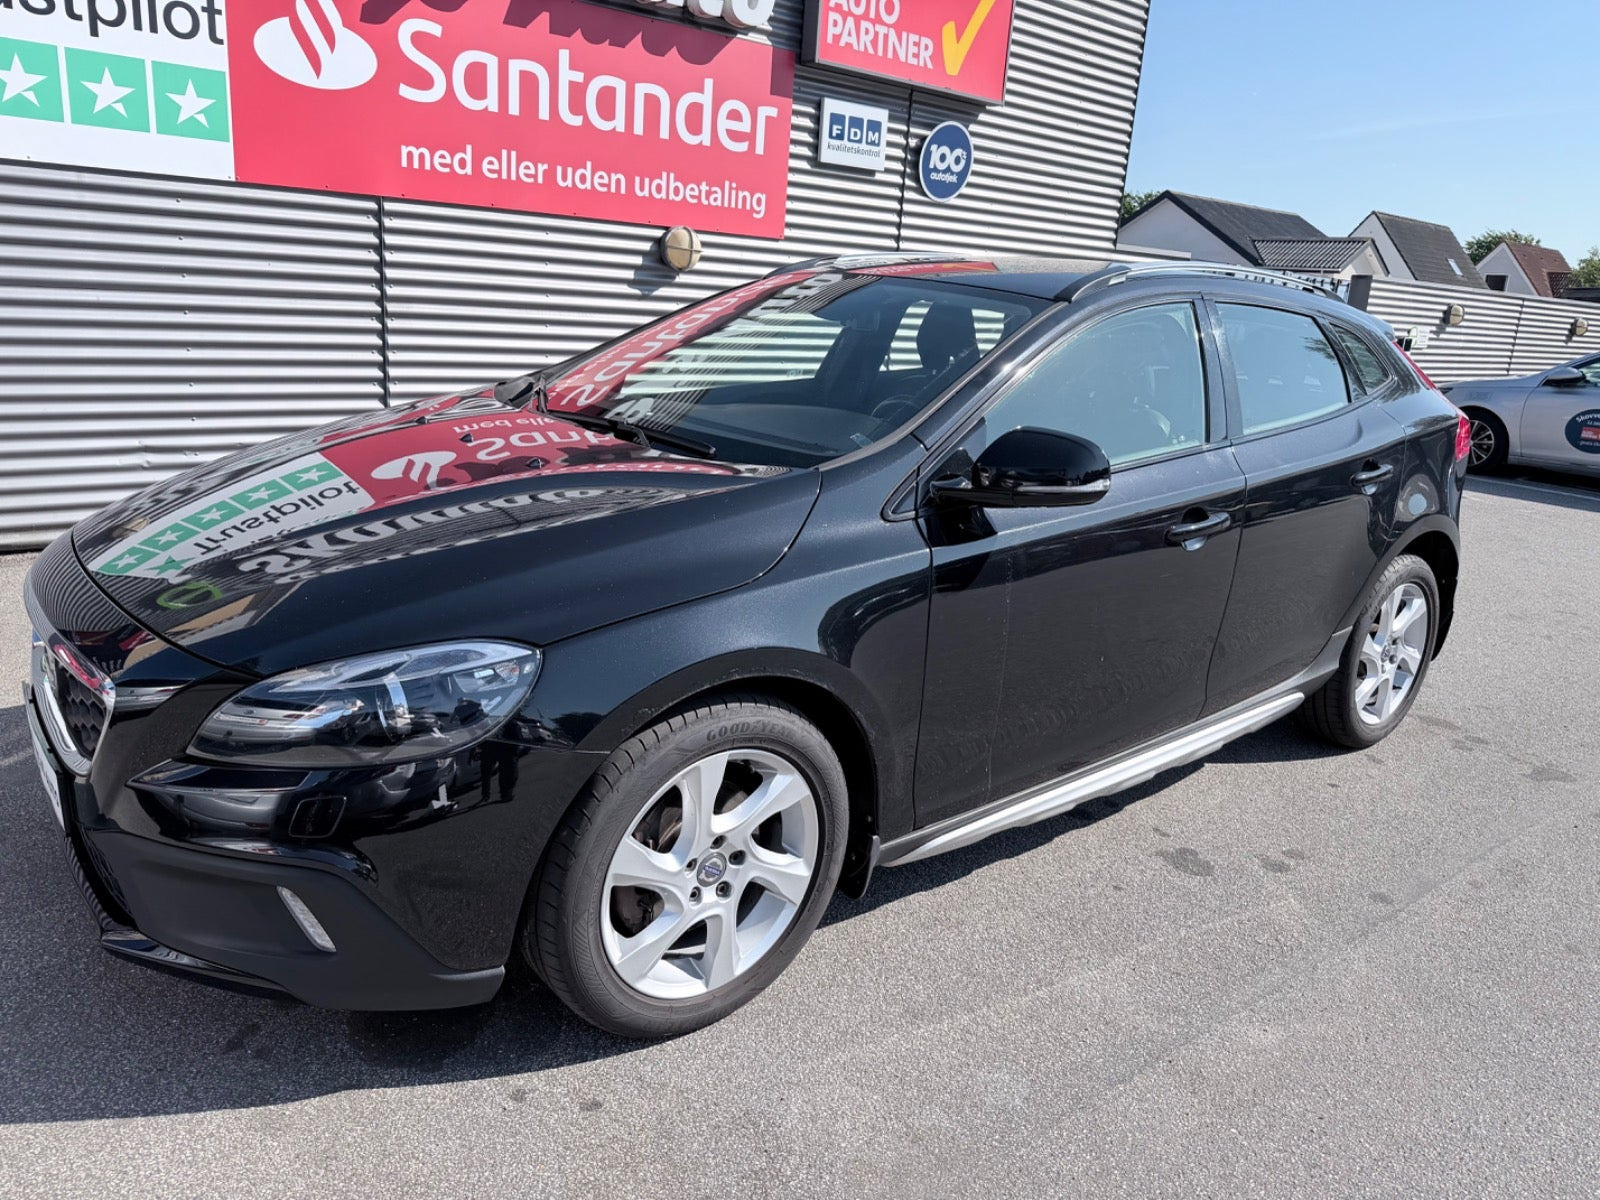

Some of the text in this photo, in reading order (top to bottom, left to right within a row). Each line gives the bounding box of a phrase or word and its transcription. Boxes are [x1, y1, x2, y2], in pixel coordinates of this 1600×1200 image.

[826, 10, 934, 69] PARTNER
[397, 17, 779, 156] Santander
[827, 142, 882, 158] kvalitetskontrol
[831, 124, 881, 146] FDM
[400, 144, 767, 219] med eller uden udbetaling
